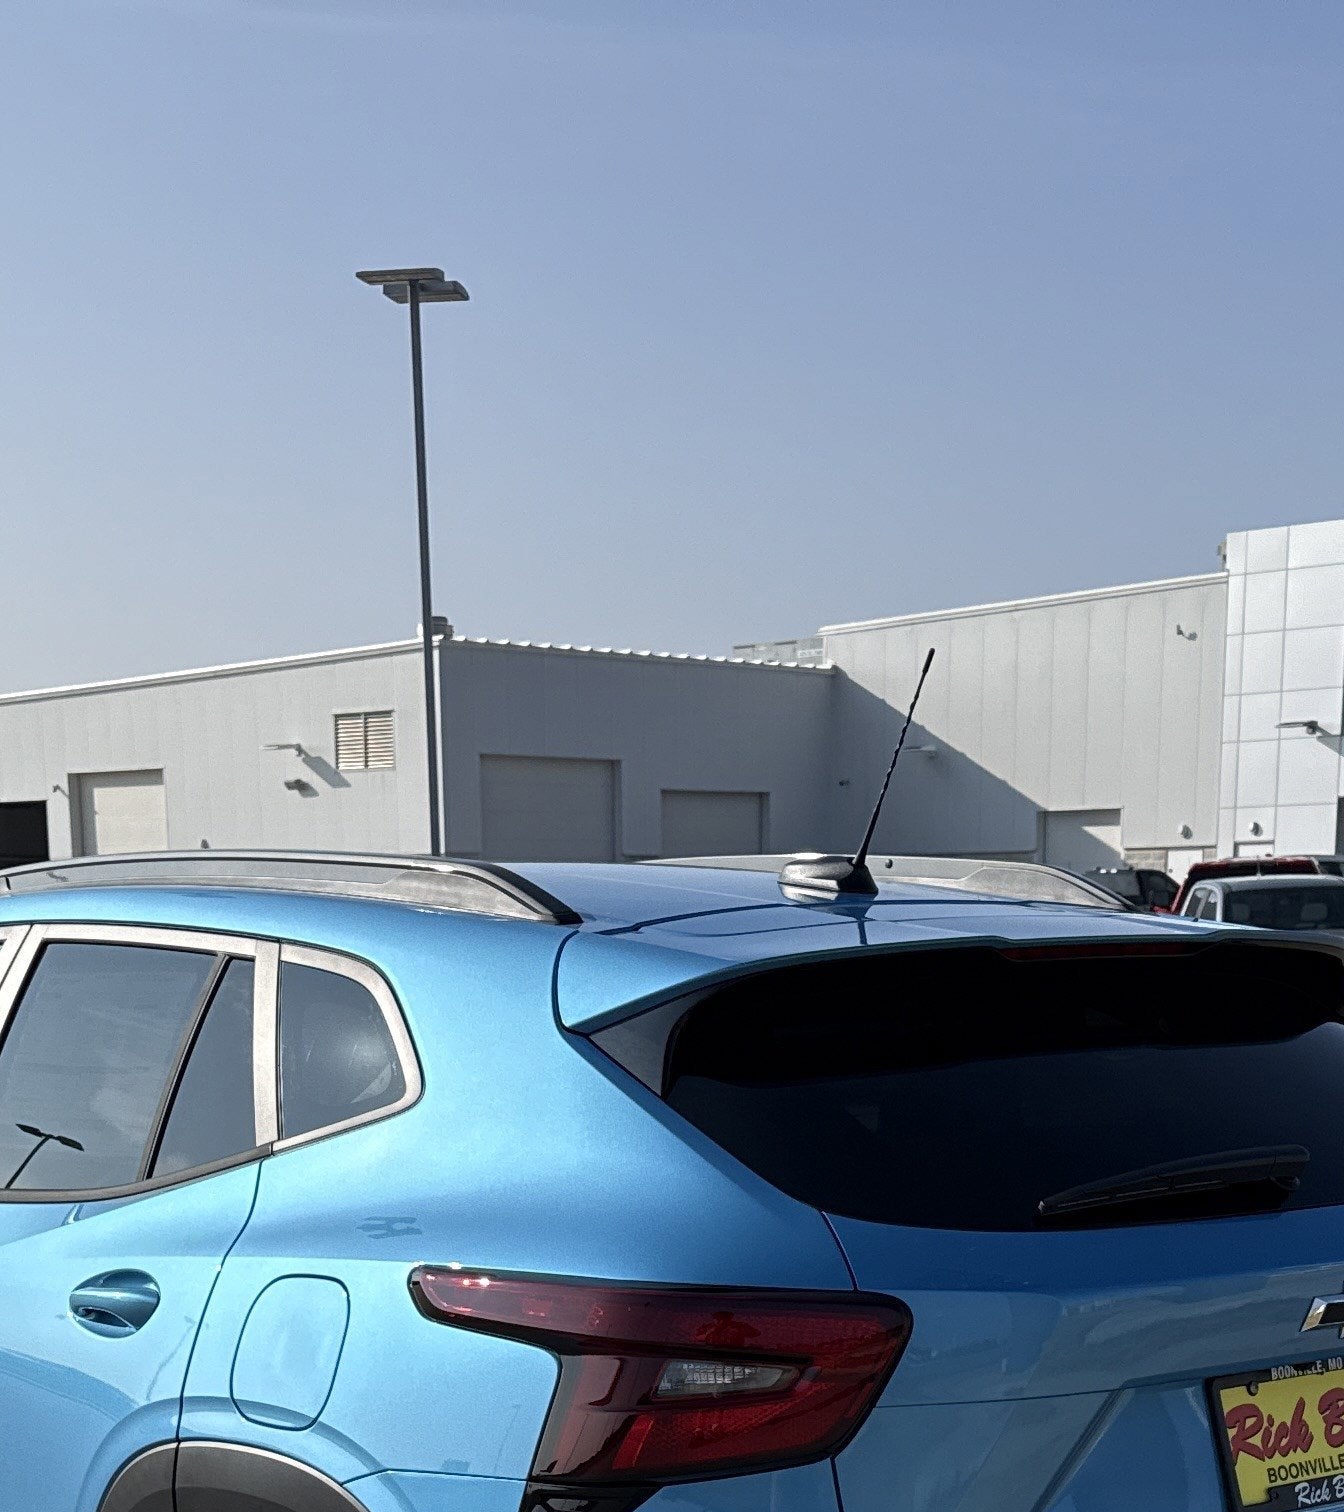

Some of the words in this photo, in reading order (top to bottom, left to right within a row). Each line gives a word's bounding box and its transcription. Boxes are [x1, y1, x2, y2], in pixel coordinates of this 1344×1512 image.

[1328, 1357, 1343, 1370] MO
[1225, 1397, 1314, 1466] Rick
[1295, 1483, 1331, 1507] Rick
